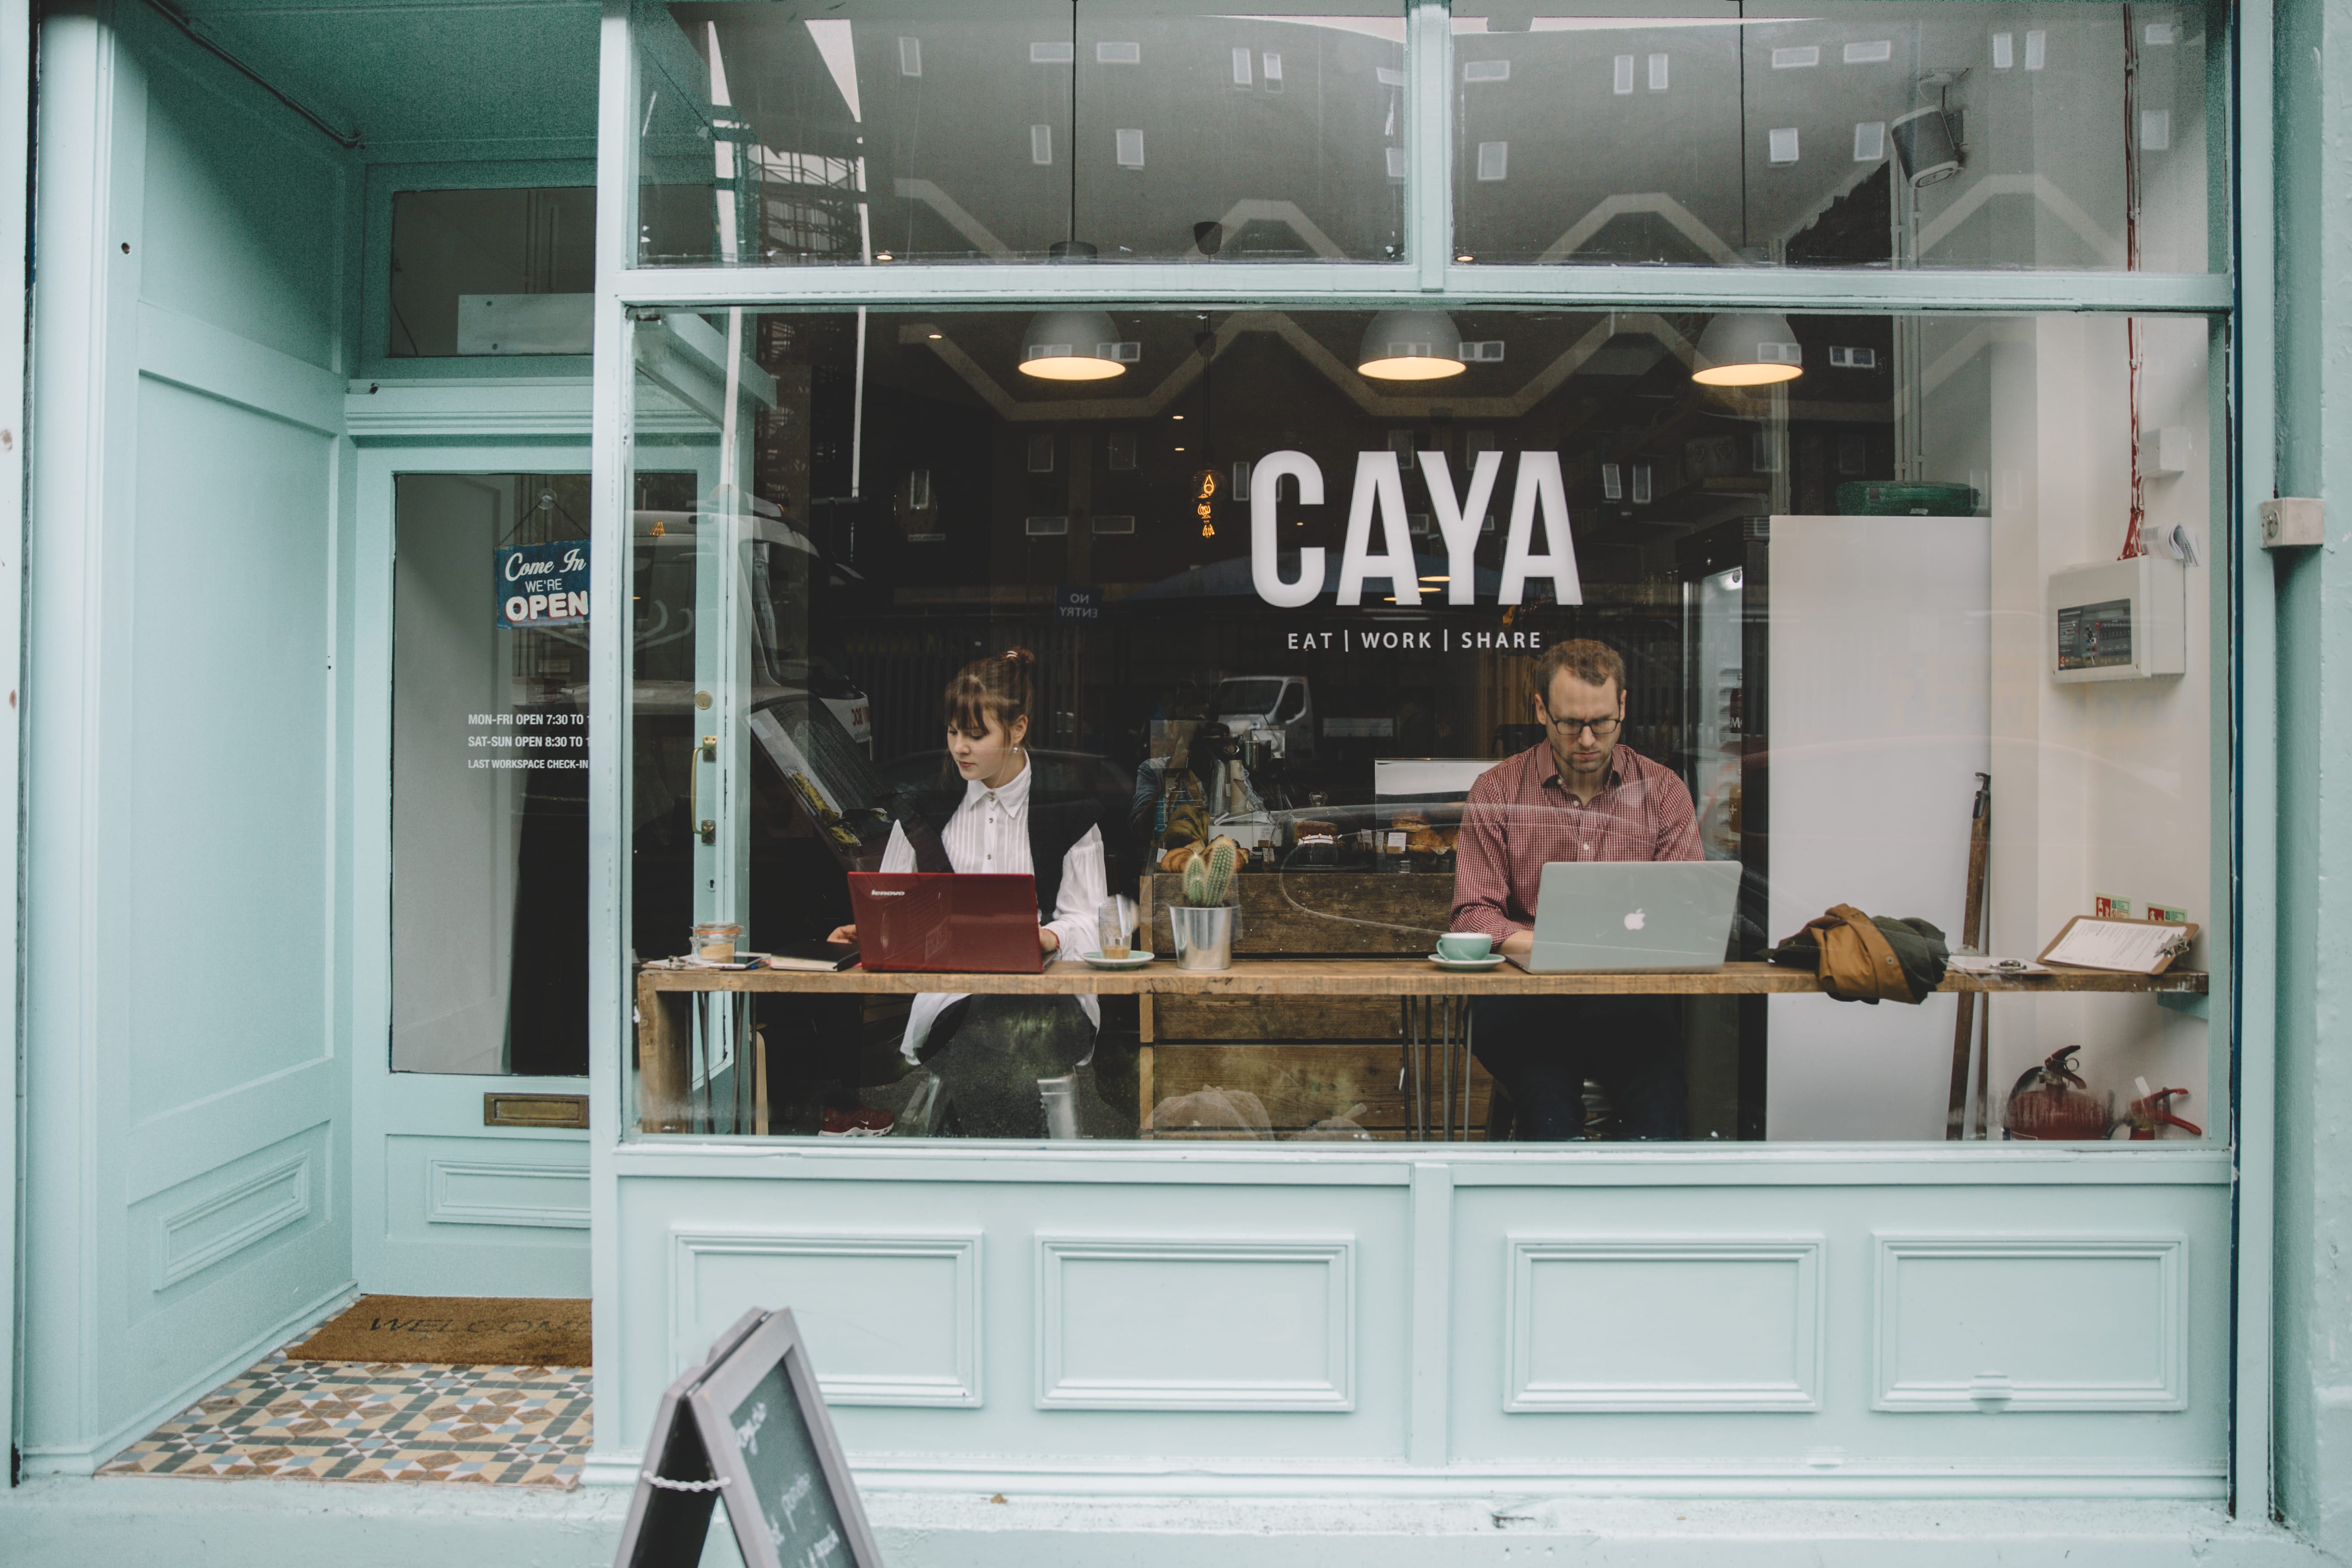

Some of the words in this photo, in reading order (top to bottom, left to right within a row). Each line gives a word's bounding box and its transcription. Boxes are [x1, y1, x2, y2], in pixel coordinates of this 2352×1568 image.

[1251, 450, 1583, 607] CAYA
[505, 553, 554, 581] Come
[559, 549, 586, 572] In
[525, 579, 562, 593] WE'RE
[505, 590, 588, 623] OPEN
[1288, 632, 1333, 649] EAT
[1361, 632, 1431, 649] WORK
[1461, 632, 1540, 648] SHARE
[468, 714, 513, 725] MON-FRI
[516, 714, 543, 725] OPEN
[546, 714, 568, 725] 7:30
[570, 714, 584, 725] TO
[468, 736, 512, 747] SAT-SUN
[515, 736, 542, 747] OPEN
[545, 736, 567, 747] 8:30
[569, 736, 583, 747] TO
[468, 760, 490, 768] LAST
[491, 760, 545, 768] WORKSPACE
[547, 760, 588, 768] CHECK-IN
